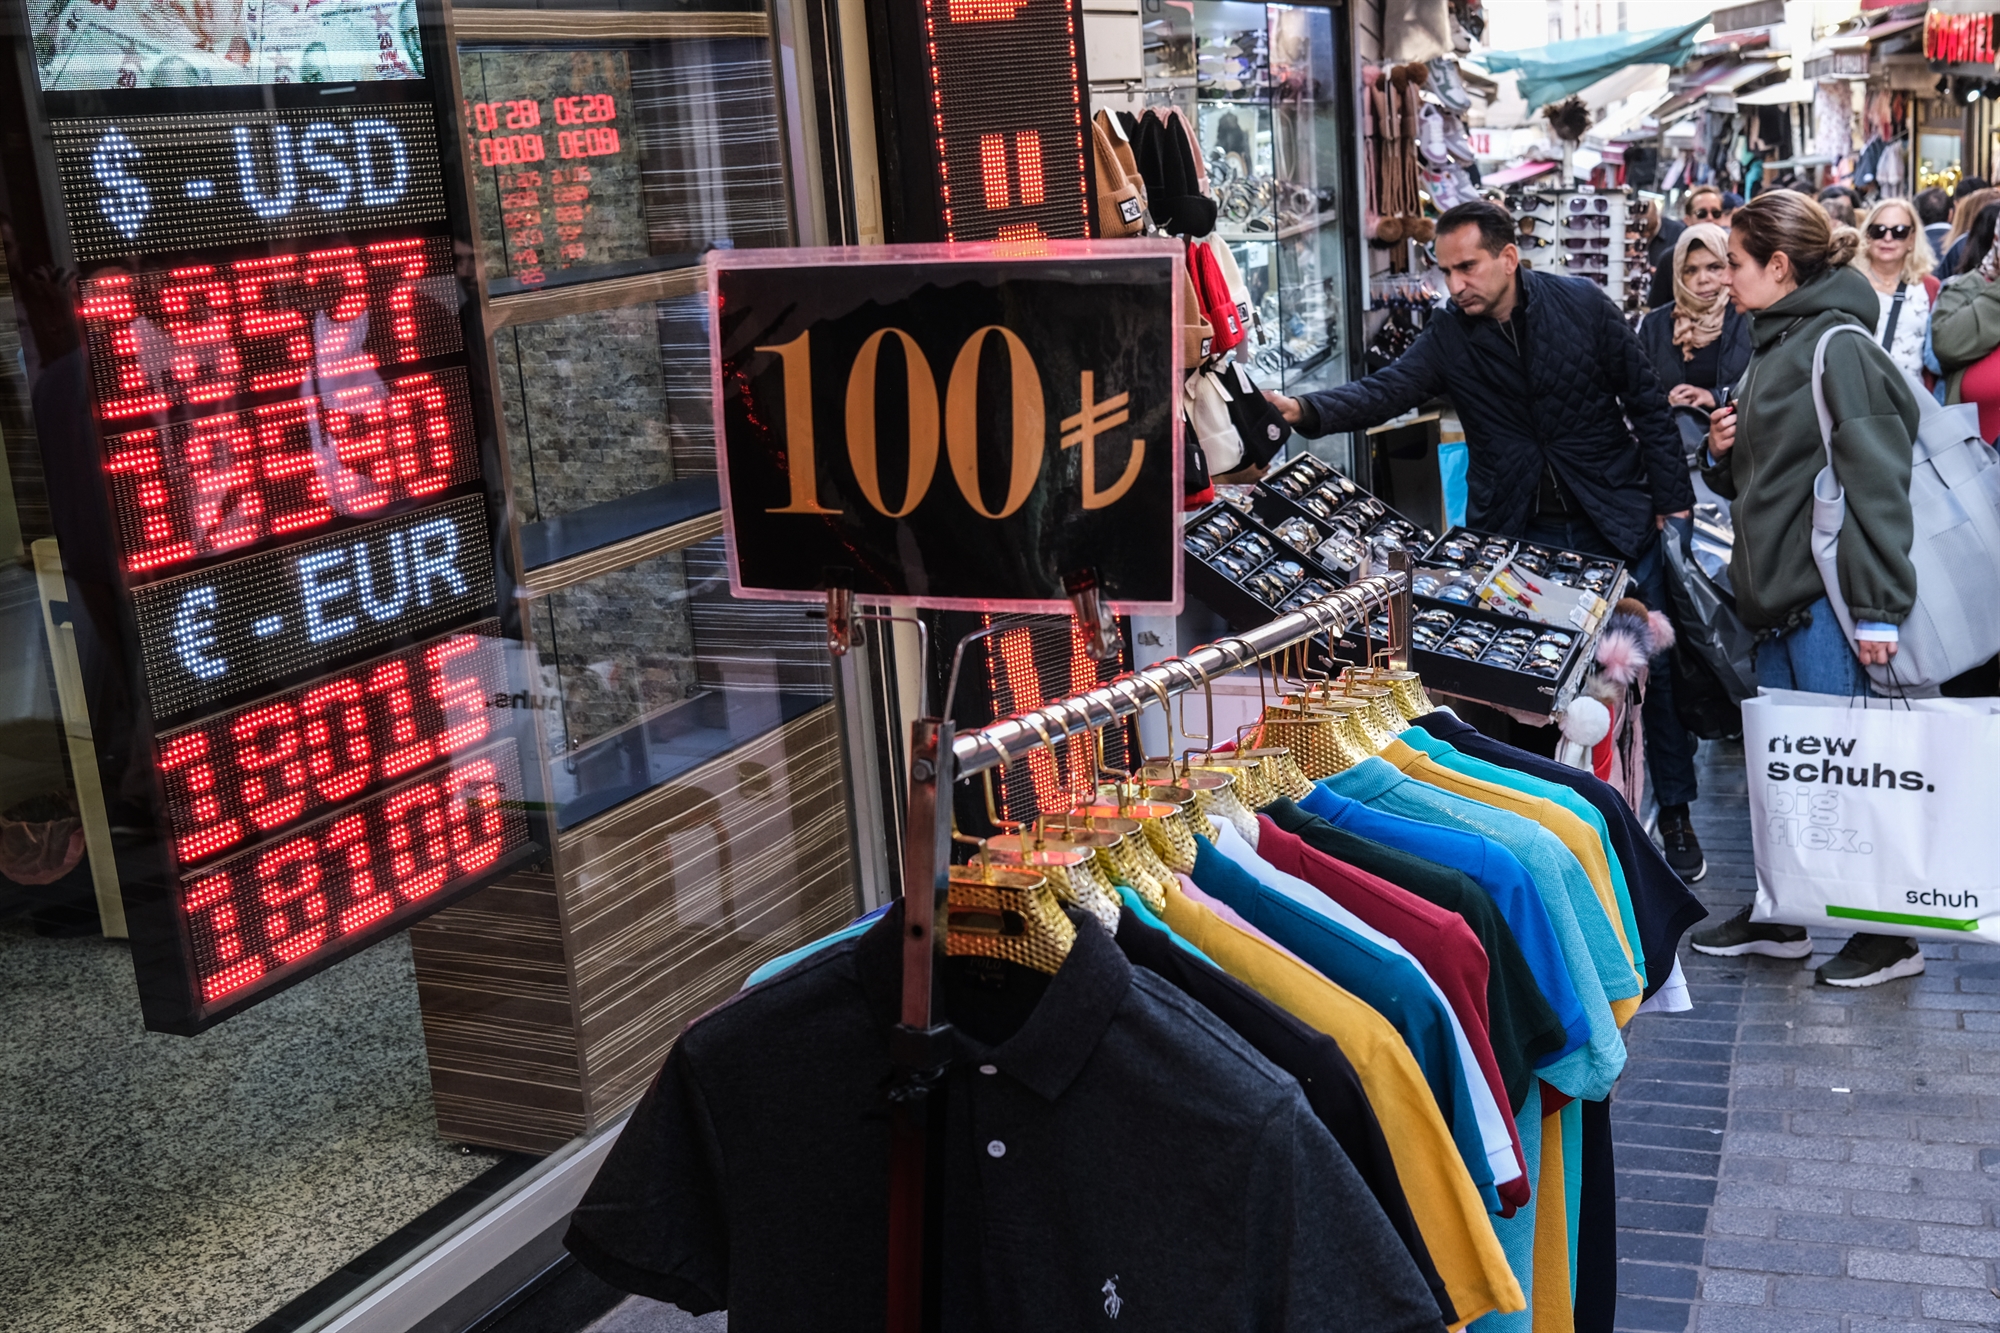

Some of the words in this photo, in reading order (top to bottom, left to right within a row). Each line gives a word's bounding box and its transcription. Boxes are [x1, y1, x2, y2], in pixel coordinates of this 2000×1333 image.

[91, 126, 152, 239] $
[234, 118, 410, 218] USD
[77, 239, 426, 419] 18527
[105, 373, 455, 572] 18590
[171, 586, 227, 680] €
[297, 518, 470, 644] EUR
[157, 637, 489, 862] 18015
[1766, 759, 1935, 793] schuhs.
[1766, 783, 1840, 826] big
[1767, 734, 1857, 757] new
[182, 760, 503, 1002] 18100
[1767, 817, 1875, 855] flex.
[1905, 888, 1978, 908] schuh
